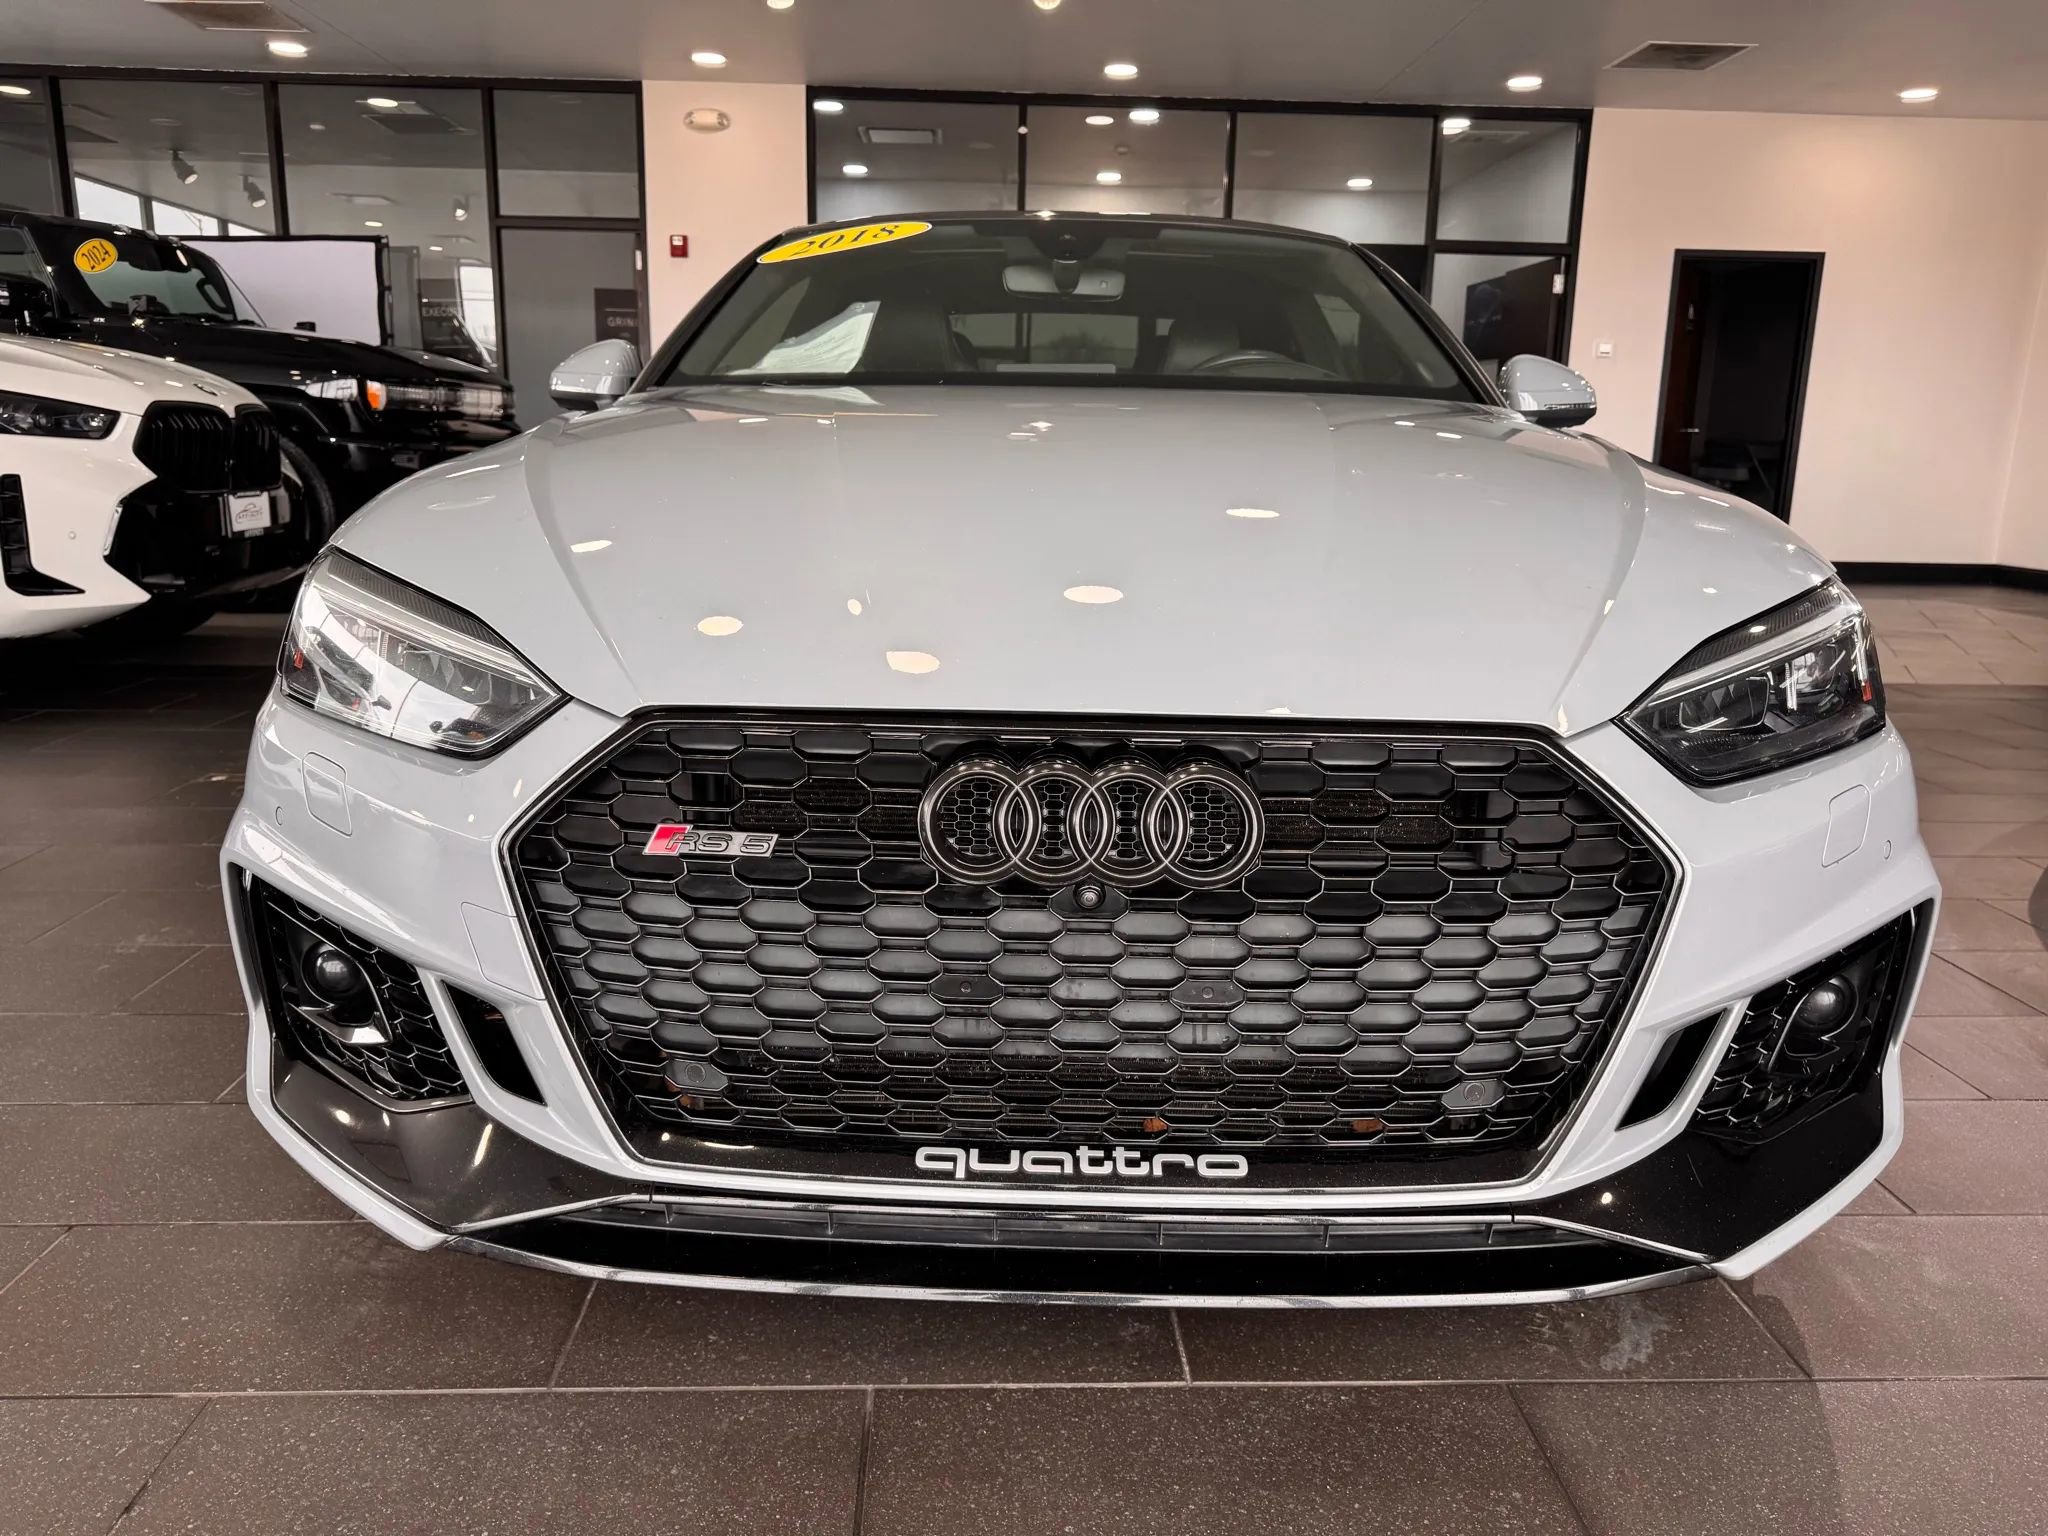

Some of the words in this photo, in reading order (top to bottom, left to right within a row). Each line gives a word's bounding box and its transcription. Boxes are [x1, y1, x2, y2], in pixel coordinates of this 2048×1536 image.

[81, 241, 111, 270] 2024
[791, 225, 900, 256] 2018
[915, 1145, 1249, 1179] quattro
